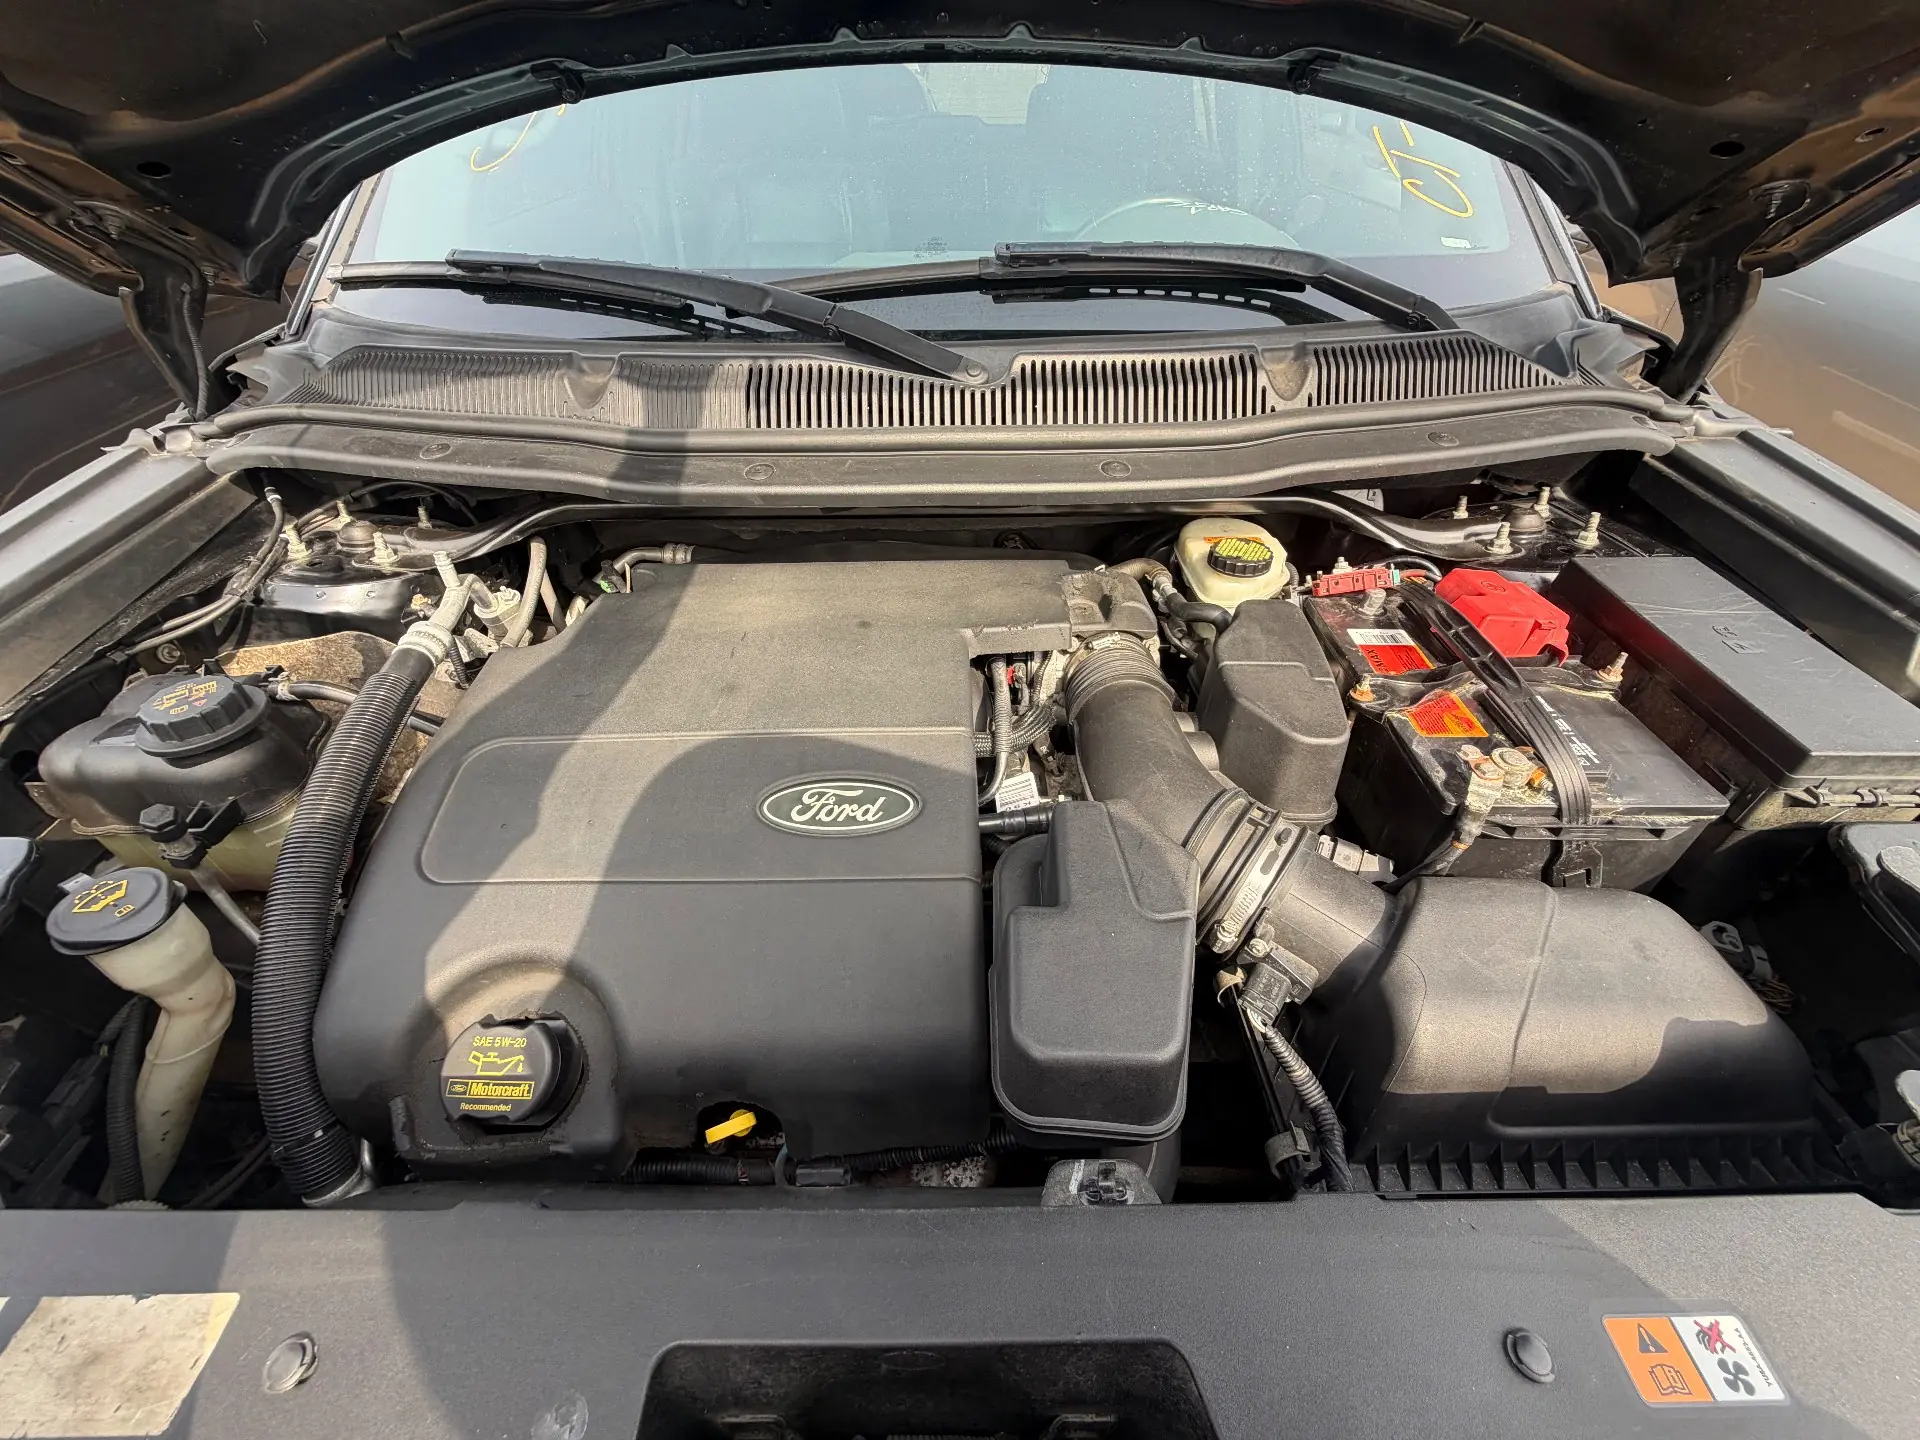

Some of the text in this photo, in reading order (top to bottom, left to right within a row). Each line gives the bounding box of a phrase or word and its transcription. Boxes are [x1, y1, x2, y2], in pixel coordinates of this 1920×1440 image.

[790, 788, 887, 822] Ford
[472, 1036, 527, 1048] SAE 5W-20
[470, 1082, 529, 1097] Motorcraft
[460, 1102, 512, 1112] Recommended
